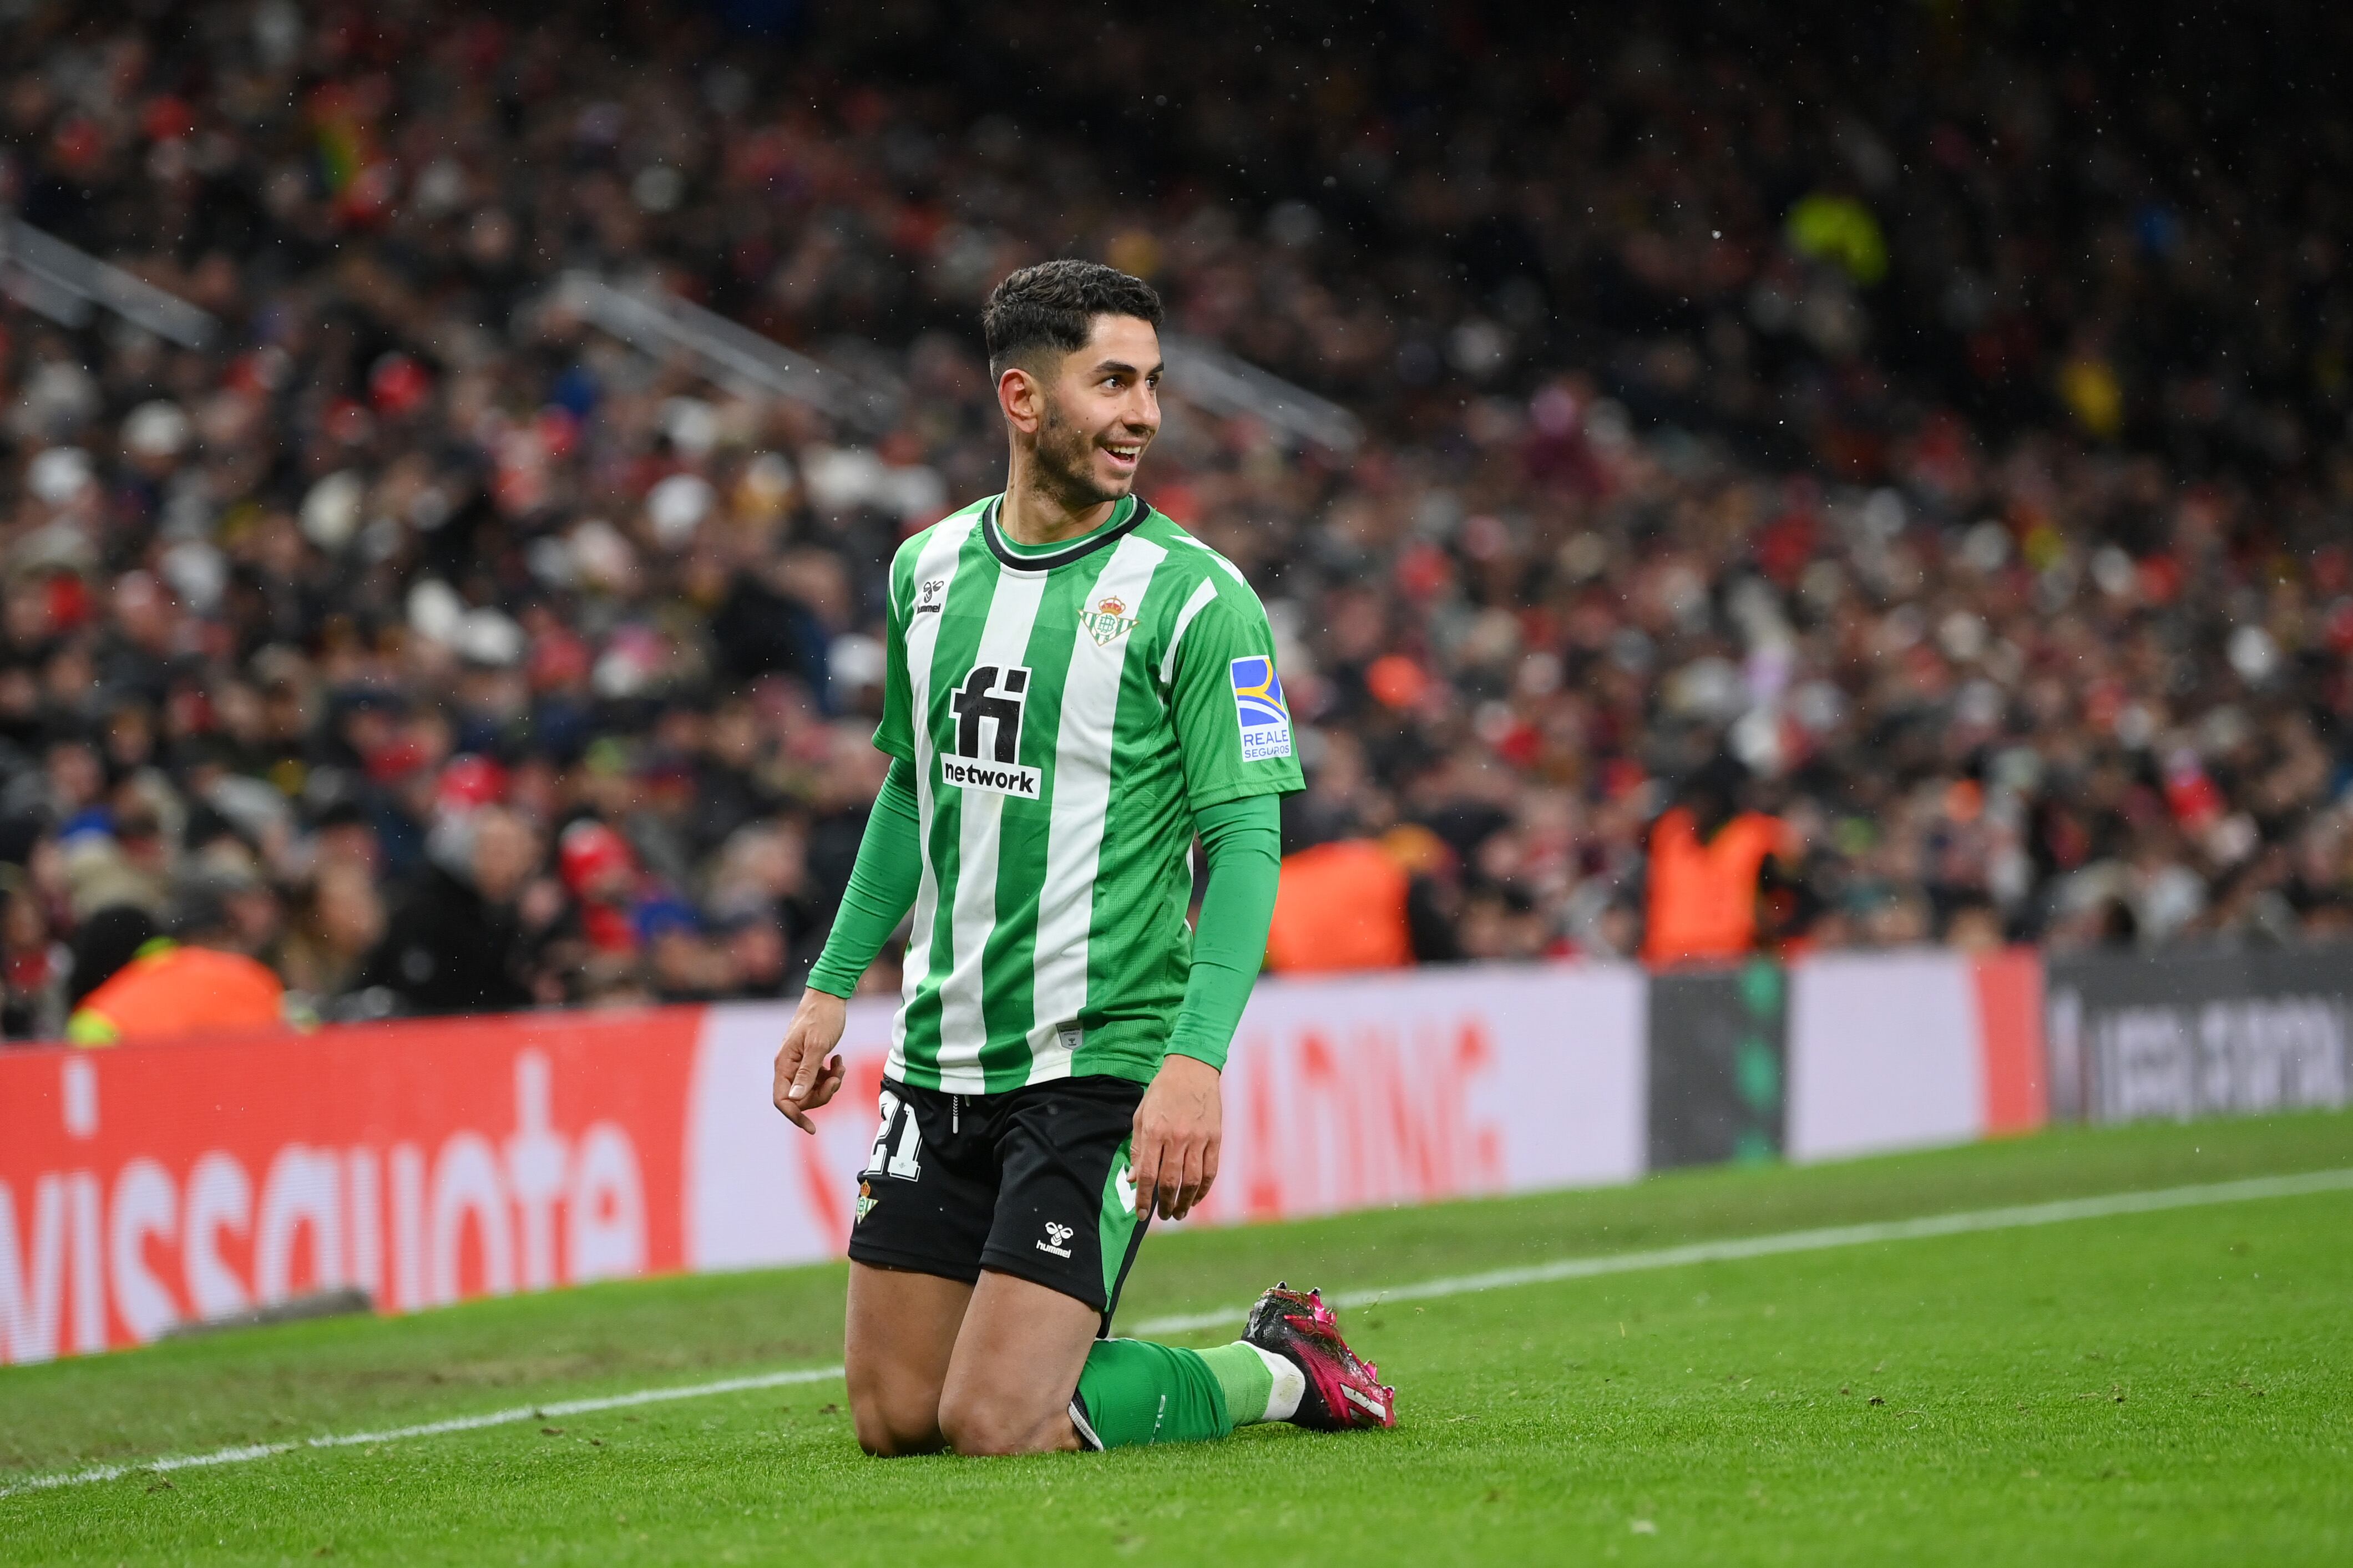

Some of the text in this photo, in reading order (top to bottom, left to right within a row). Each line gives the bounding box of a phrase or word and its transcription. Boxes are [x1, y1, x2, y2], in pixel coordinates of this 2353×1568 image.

[953, 666, 1027, 764] fi
[1243, 729, 1288, 747] REALE
[1244, 744, 1289, 758] SEGUROS
[945, 763, 1035, 794] network
[863, 1090, 922, 1182] 21
[1036, 1239, 1071, 1259] hummel
